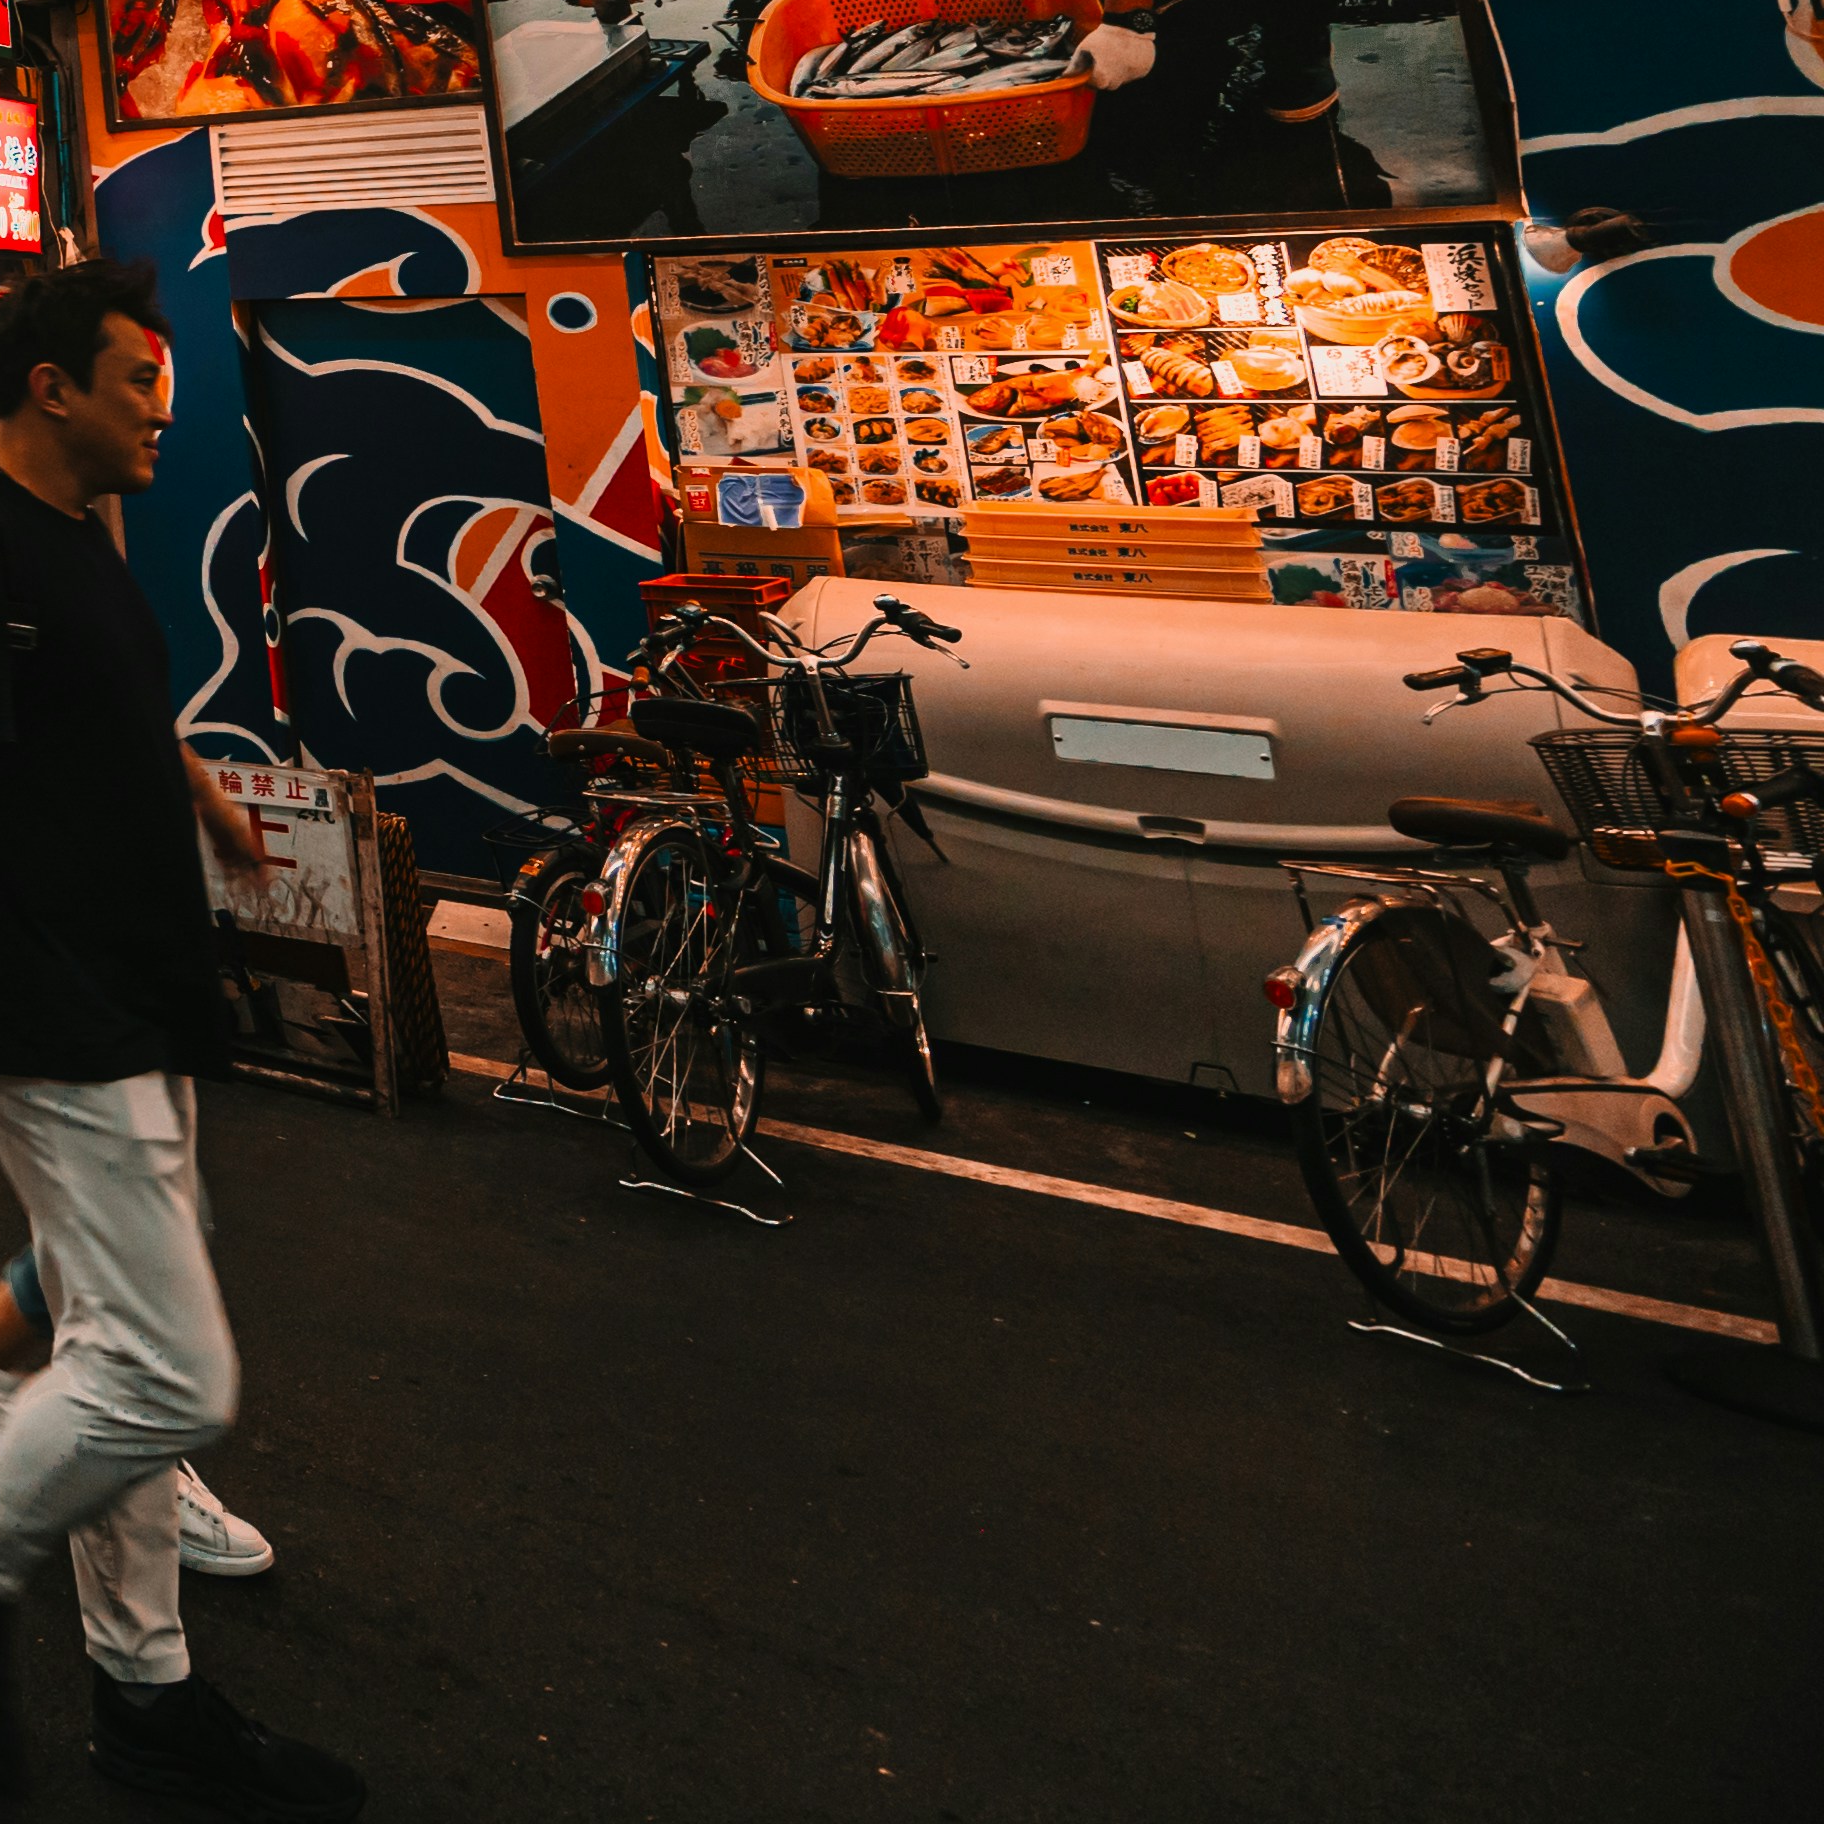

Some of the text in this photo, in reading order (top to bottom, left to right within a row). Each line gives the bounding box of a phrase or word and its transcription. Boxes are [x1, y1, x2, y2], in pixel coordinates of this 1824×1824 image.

[1447, 243, 1485, 310] 浜焼セット
[217, 768, 311, 802] 輪禁止
